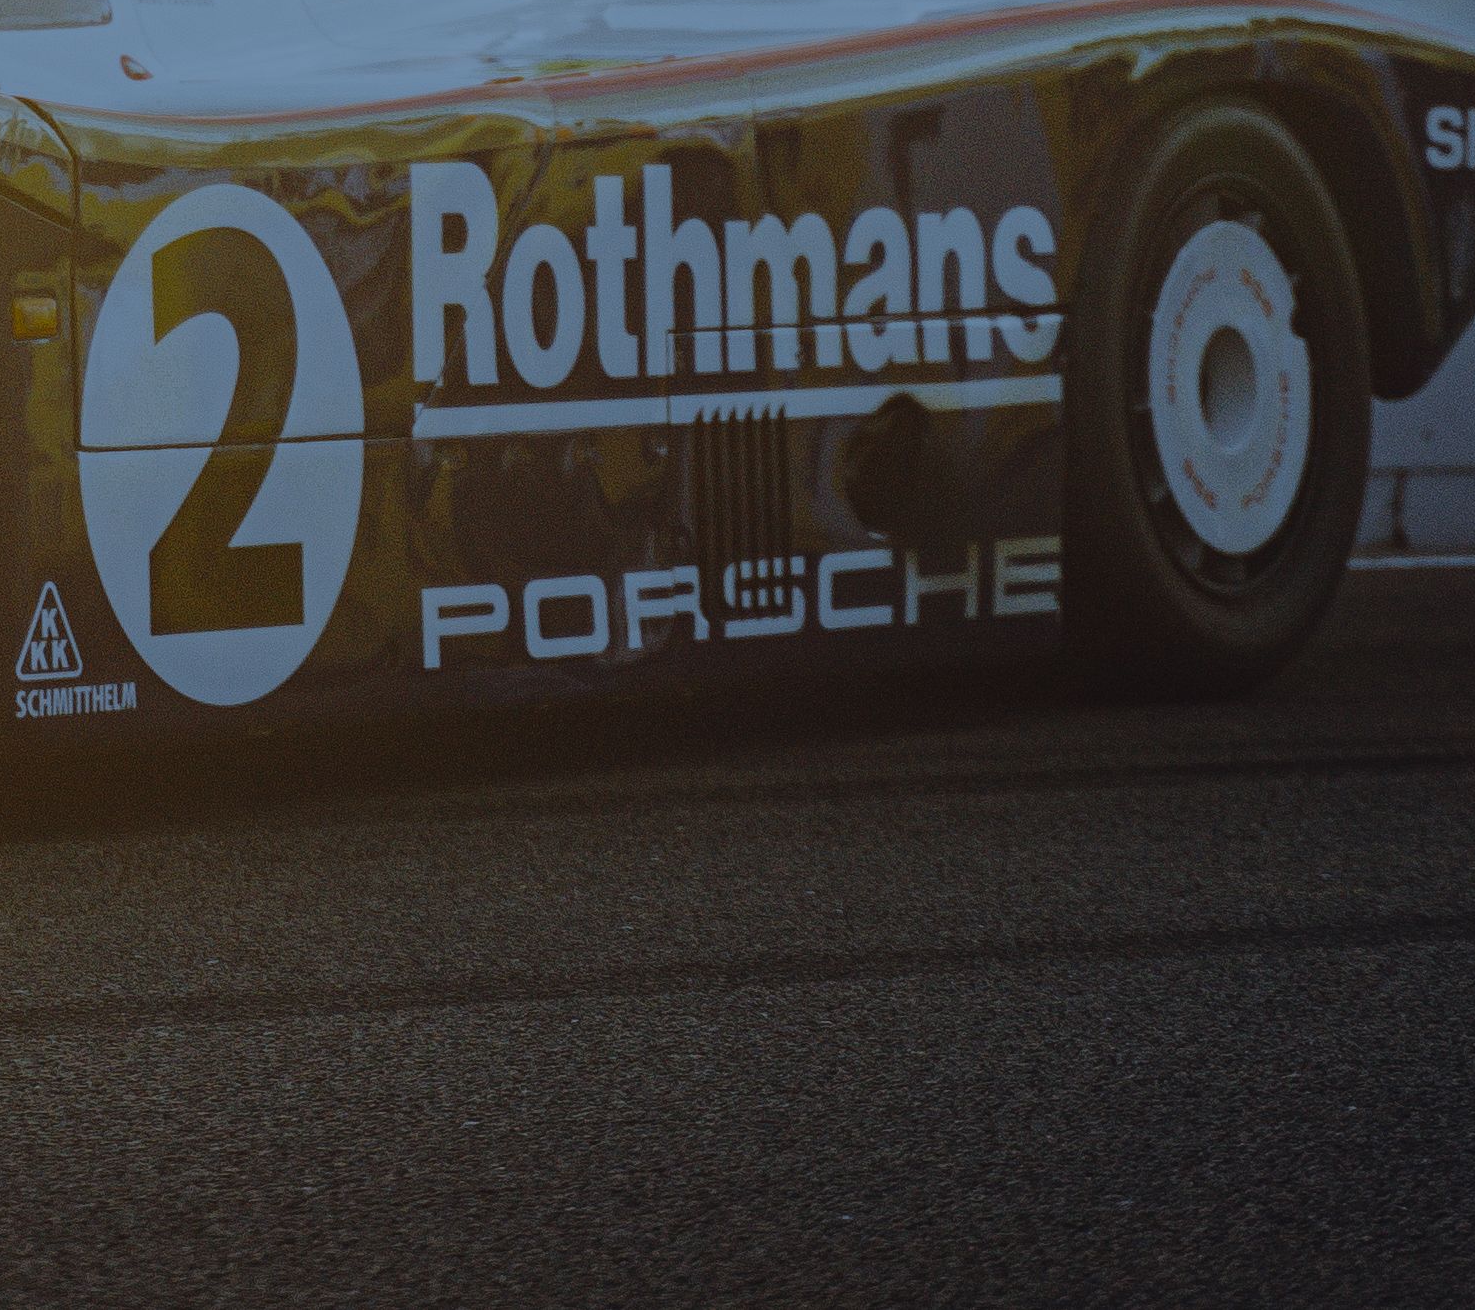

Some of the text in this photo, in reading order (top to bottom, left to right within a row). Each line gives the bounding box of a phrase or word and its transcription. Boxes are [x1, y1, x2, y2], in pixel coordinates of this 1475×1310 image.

[410, 160, 1063, 388] Rothmans
[149, 225, 307, 637] 2
[420, 535, 1063, 670] PORSCHE
[15, 681, 138, 719] SCHMITTHELM
